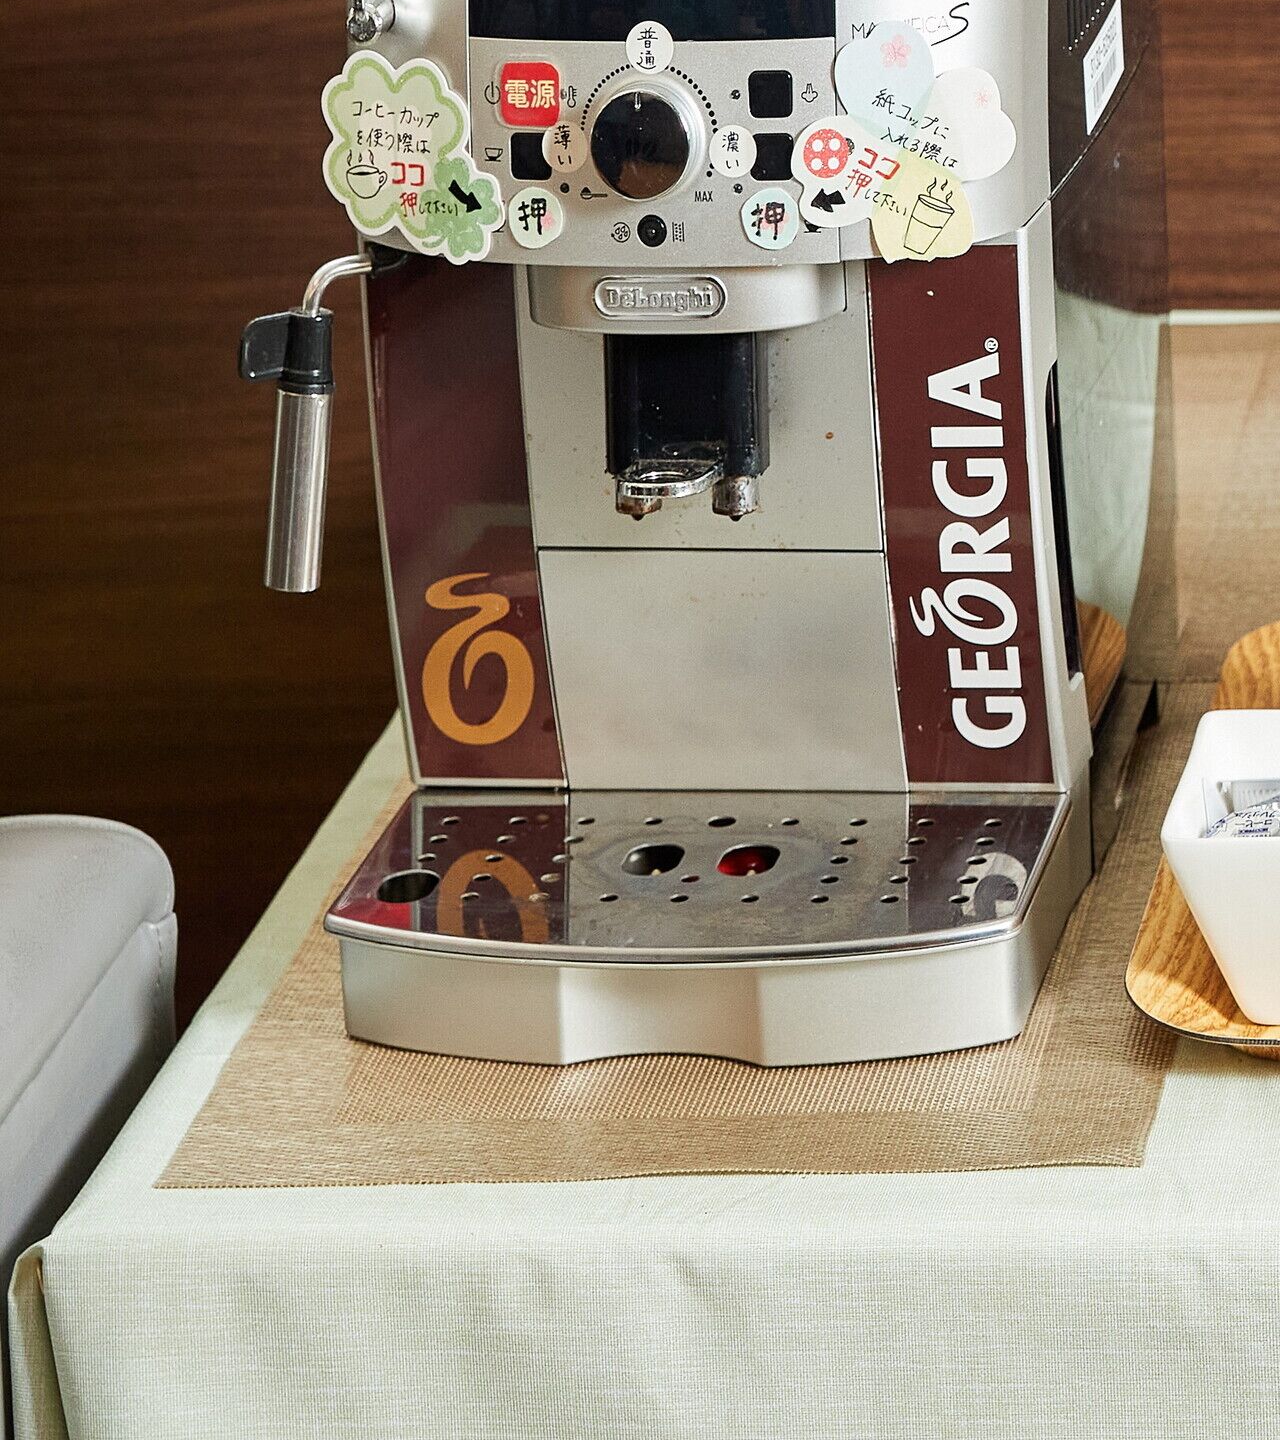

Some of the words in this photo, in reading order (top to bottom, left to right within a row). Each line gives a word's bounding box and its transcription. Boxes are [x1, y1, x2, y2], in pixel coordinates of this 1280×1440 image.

[636, 27, 659, 70] 普通
[504, 78, 557, 110] 電源
[871, 87, 951, 140] 紙コップに
[351, 100, 441, 129] コーヒーカップ
[355, 128, 432, 155] を使う際は
[553, 125, 572, 167] 薄い
[720, 131, 741, 170] 濃い
[879, 125, 958, 168] 入れる際は
[390, 161, 425, 187] ココ
[857, 147, 901, 180] ココ
[694, 190, 714, 203] MAX
[518, 197, 548, 236] 押
[750, 201, 786, 241] 押
[908, 351, 1028, 750] GEORGIA
